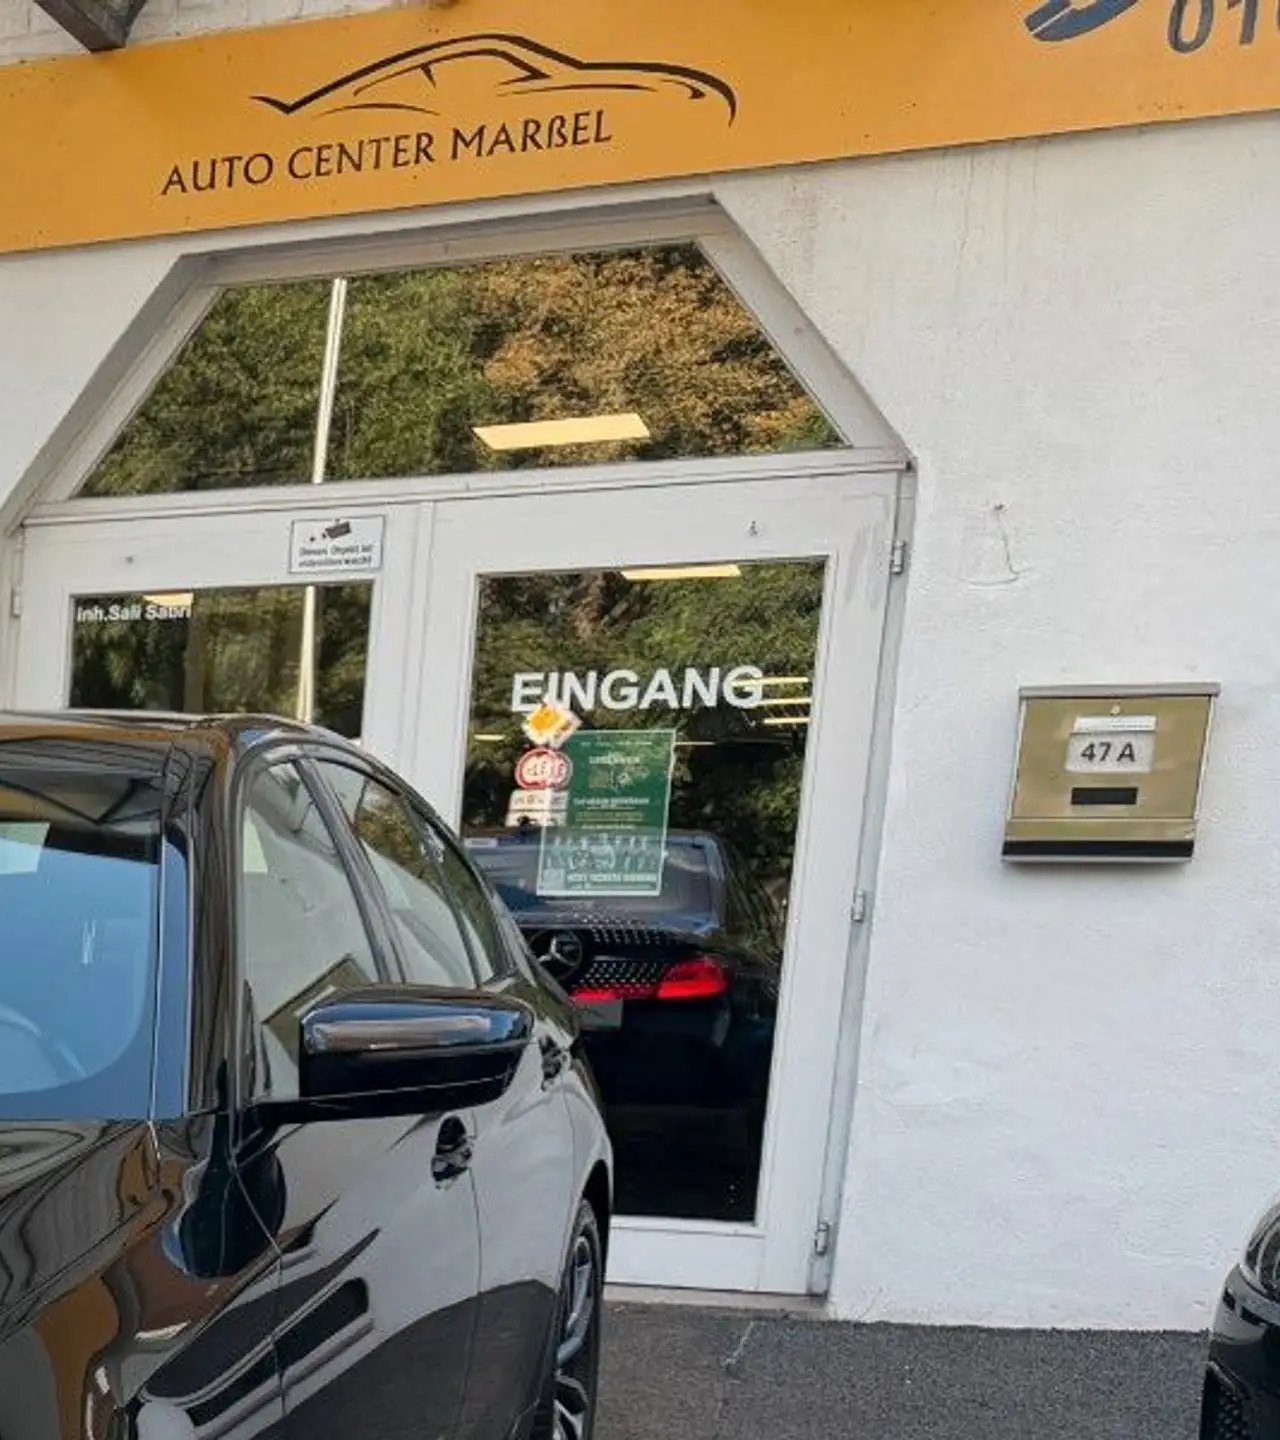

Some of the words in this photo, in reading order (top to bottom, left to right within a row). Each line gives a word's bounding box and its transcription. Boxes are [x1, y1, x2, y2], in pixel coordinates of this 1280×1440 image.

[1168, 0, 1280, 54] 01
[160, 153, 274, 196] AUTO
[288, 131, 436, 179] CENTER
[511, 665, 765, 713] EINGANG
